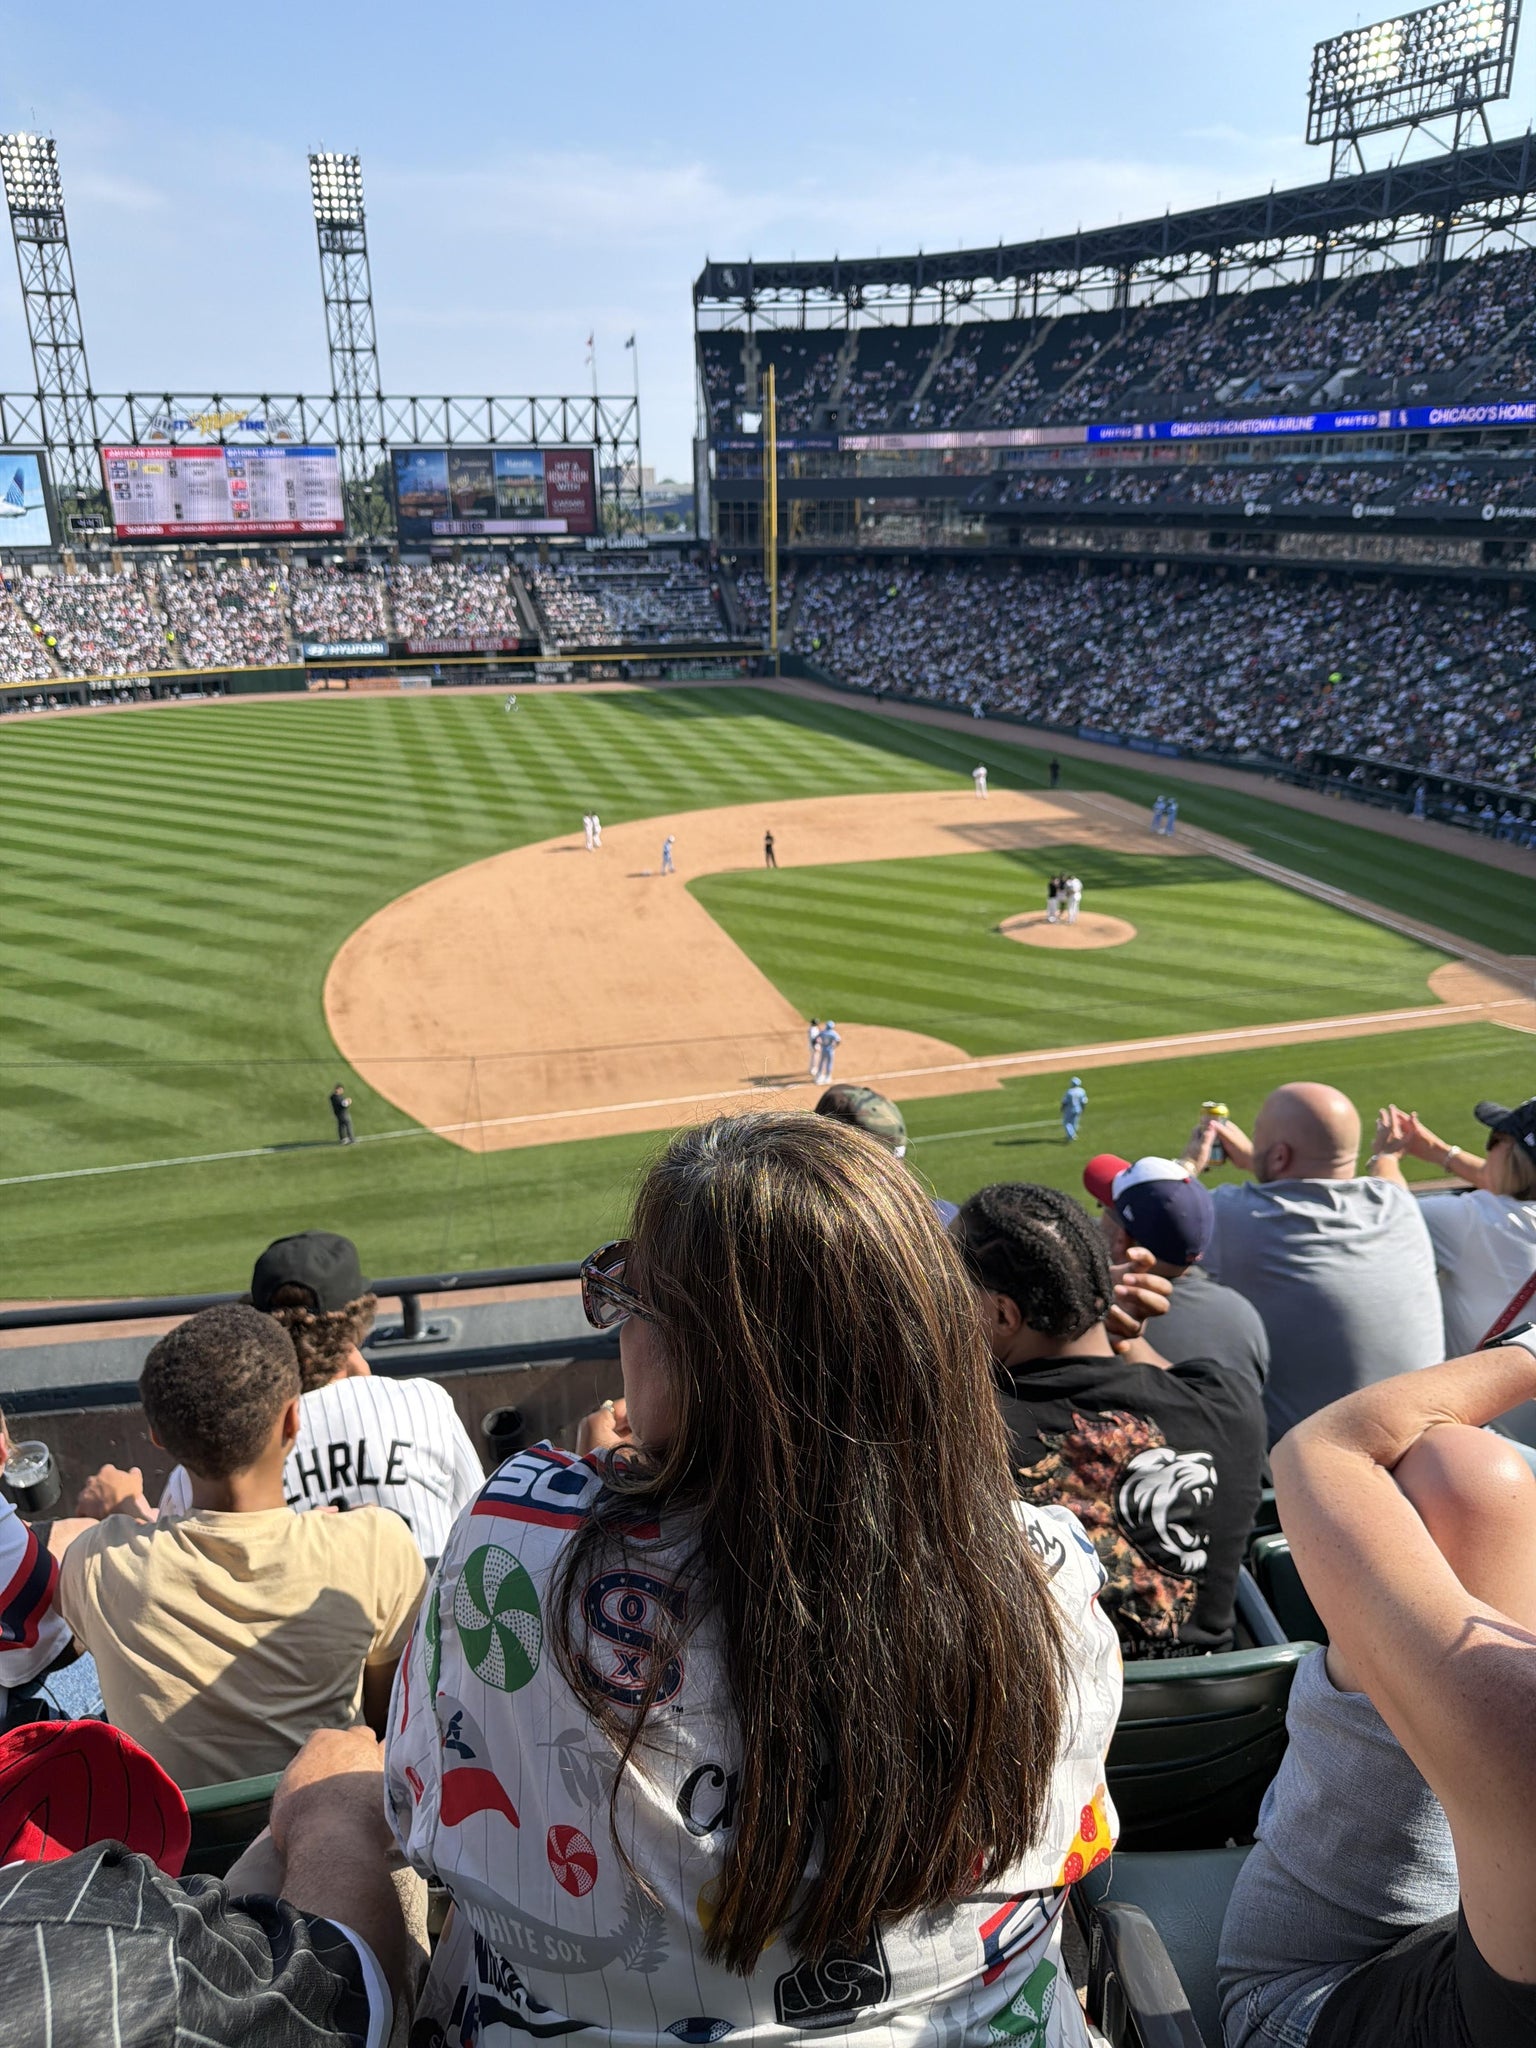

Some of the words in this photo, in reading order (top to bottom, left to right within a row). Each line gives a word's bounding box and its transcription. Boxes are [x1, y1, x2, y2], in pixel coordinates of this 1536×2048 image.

[1334, 415, 1378, 428] UNITED
[1428, 406, 1498, 424] CHICAGO'S
[1274, 416, 1316, 431] AIRLINE
[328, 642, 384, 655] HYUNDAI
[463, 1898, 539, 1955] WHITE
[543, 1933, 588, 1964] SOX
